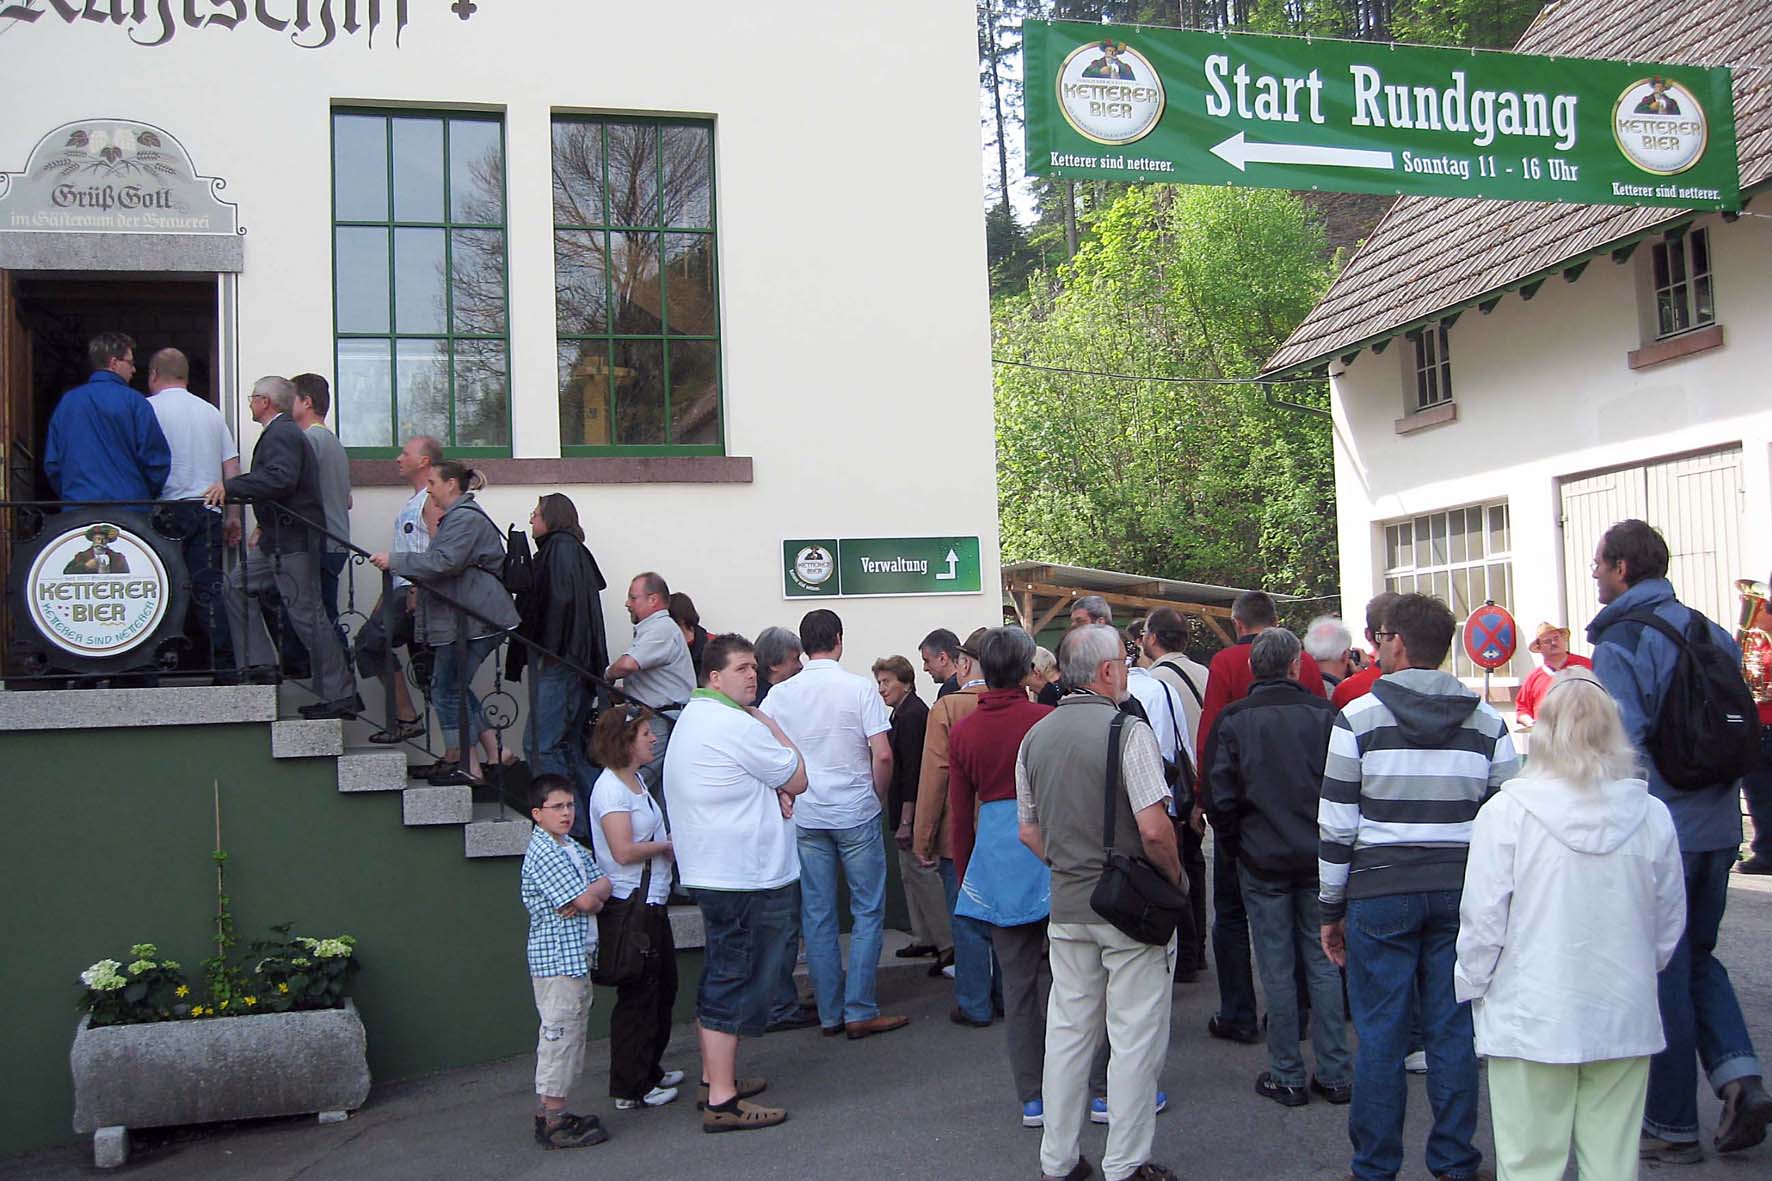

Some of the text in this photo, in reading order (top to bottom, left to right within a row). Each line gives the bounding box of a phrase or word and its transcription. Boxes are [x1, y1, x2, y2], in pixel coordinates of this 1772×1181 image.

[1063, 82, 1158, 104] KETTERER
[1203, 53, 1325, 125] Start
[1348, 64, 1578, 151] Rundgang
[1089, 101, 1133, 119] BIER
[1618, 119, 1701, 137] KETTERER
[1641, 135, 1680, 151] BIER
[1050, 151, 1175, 173] Ketterer sind netterer.
[1402, 151, 1470, 180] Sonntag
[1477, 154, 1497, 178] 11
[1521, 156, 1541, 181] 16
[1547, 158, 1579, 182] Uhr
[1611, 182, 1721, 201] Ketterer sind netterer.
[860, 556, 928, 575] Verwaltung
[39, 580, 158, 601] KETTERER
[72, 603, 126, 622] BIER
[43, 602, 84, 643] KETTERER
[86, 635, 113, 646] SIND
